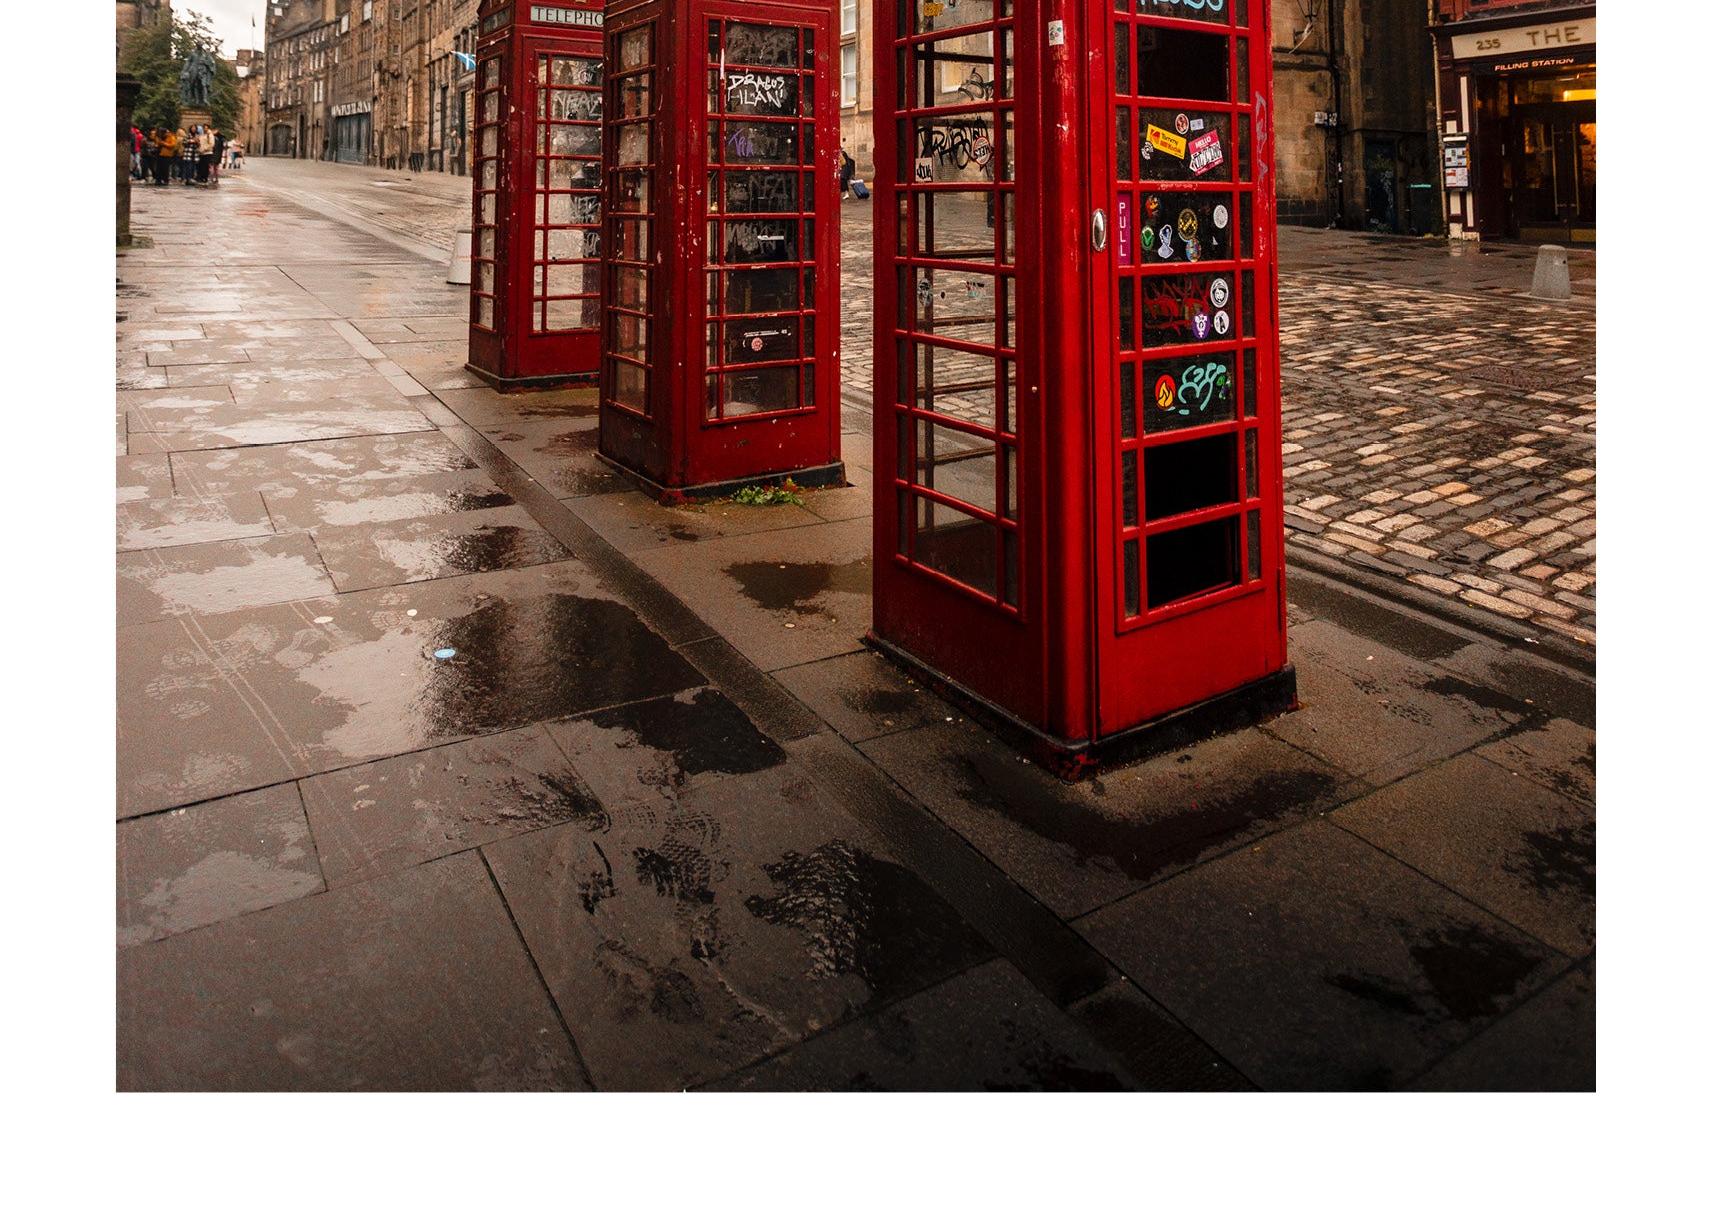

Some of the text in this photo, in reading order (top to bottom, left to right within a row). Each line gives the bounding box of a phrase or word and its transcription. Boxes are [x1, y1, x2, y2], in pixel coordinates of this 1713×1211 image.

[1476, 26, 1581, 50] 235 THE
[1494, 58, 1575, 71] FILLING STATION
[1194, 135, 1212, 149] HELLO
[1119, 202, 1127, 256] PULL
